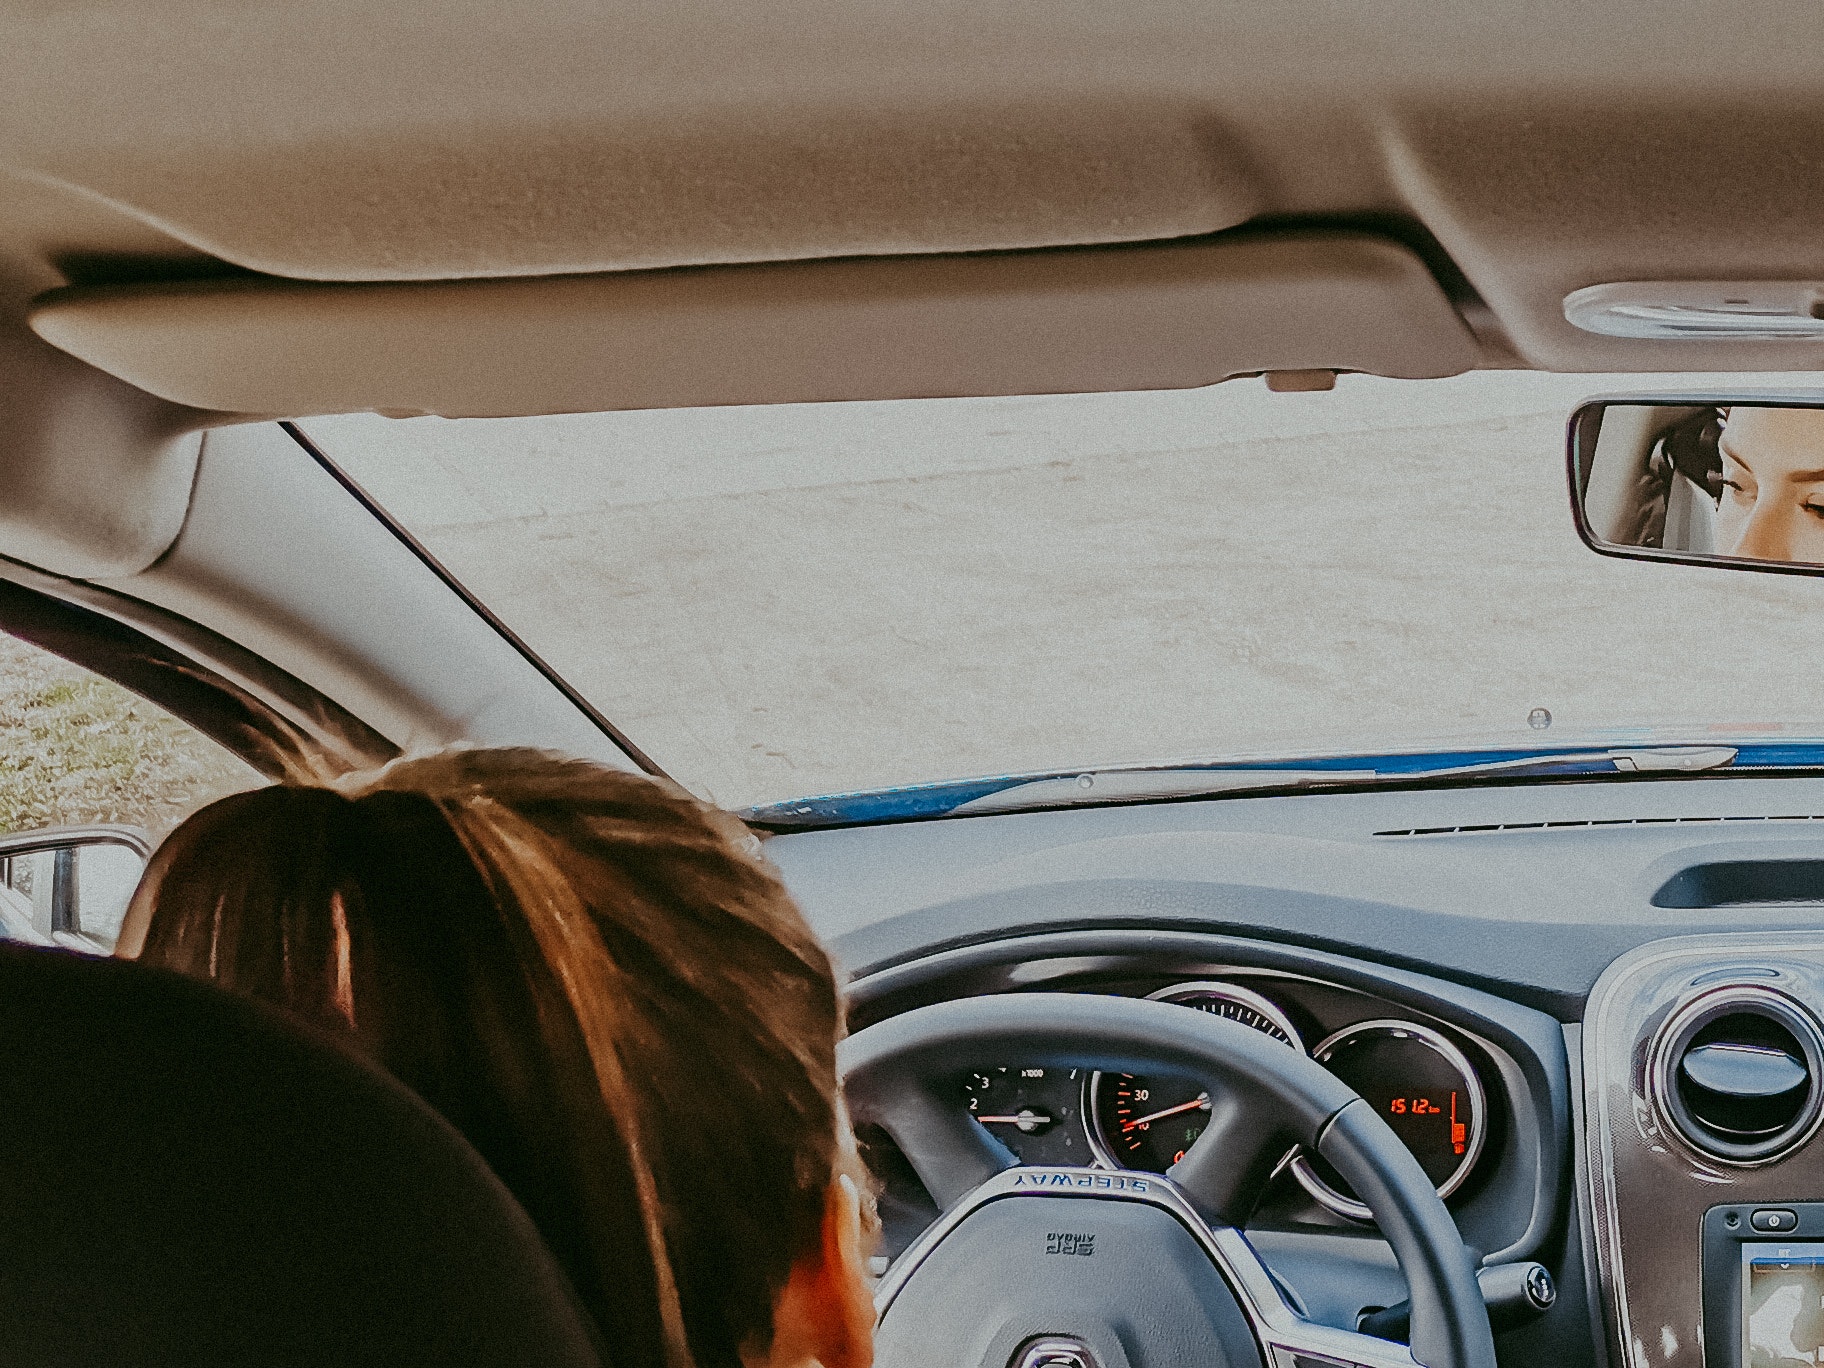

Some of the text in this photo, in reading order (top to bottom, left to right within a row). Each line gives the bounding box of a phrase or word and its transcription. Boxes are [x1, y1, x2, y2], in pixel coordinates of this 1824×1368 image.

[981, 1077, 990, 1089] 3
[1134, 1089, 1149, 1101] 30
[969, 1098, 978, 1110] 2
[1014, 1174, 1147, 1193] STEPWAY
